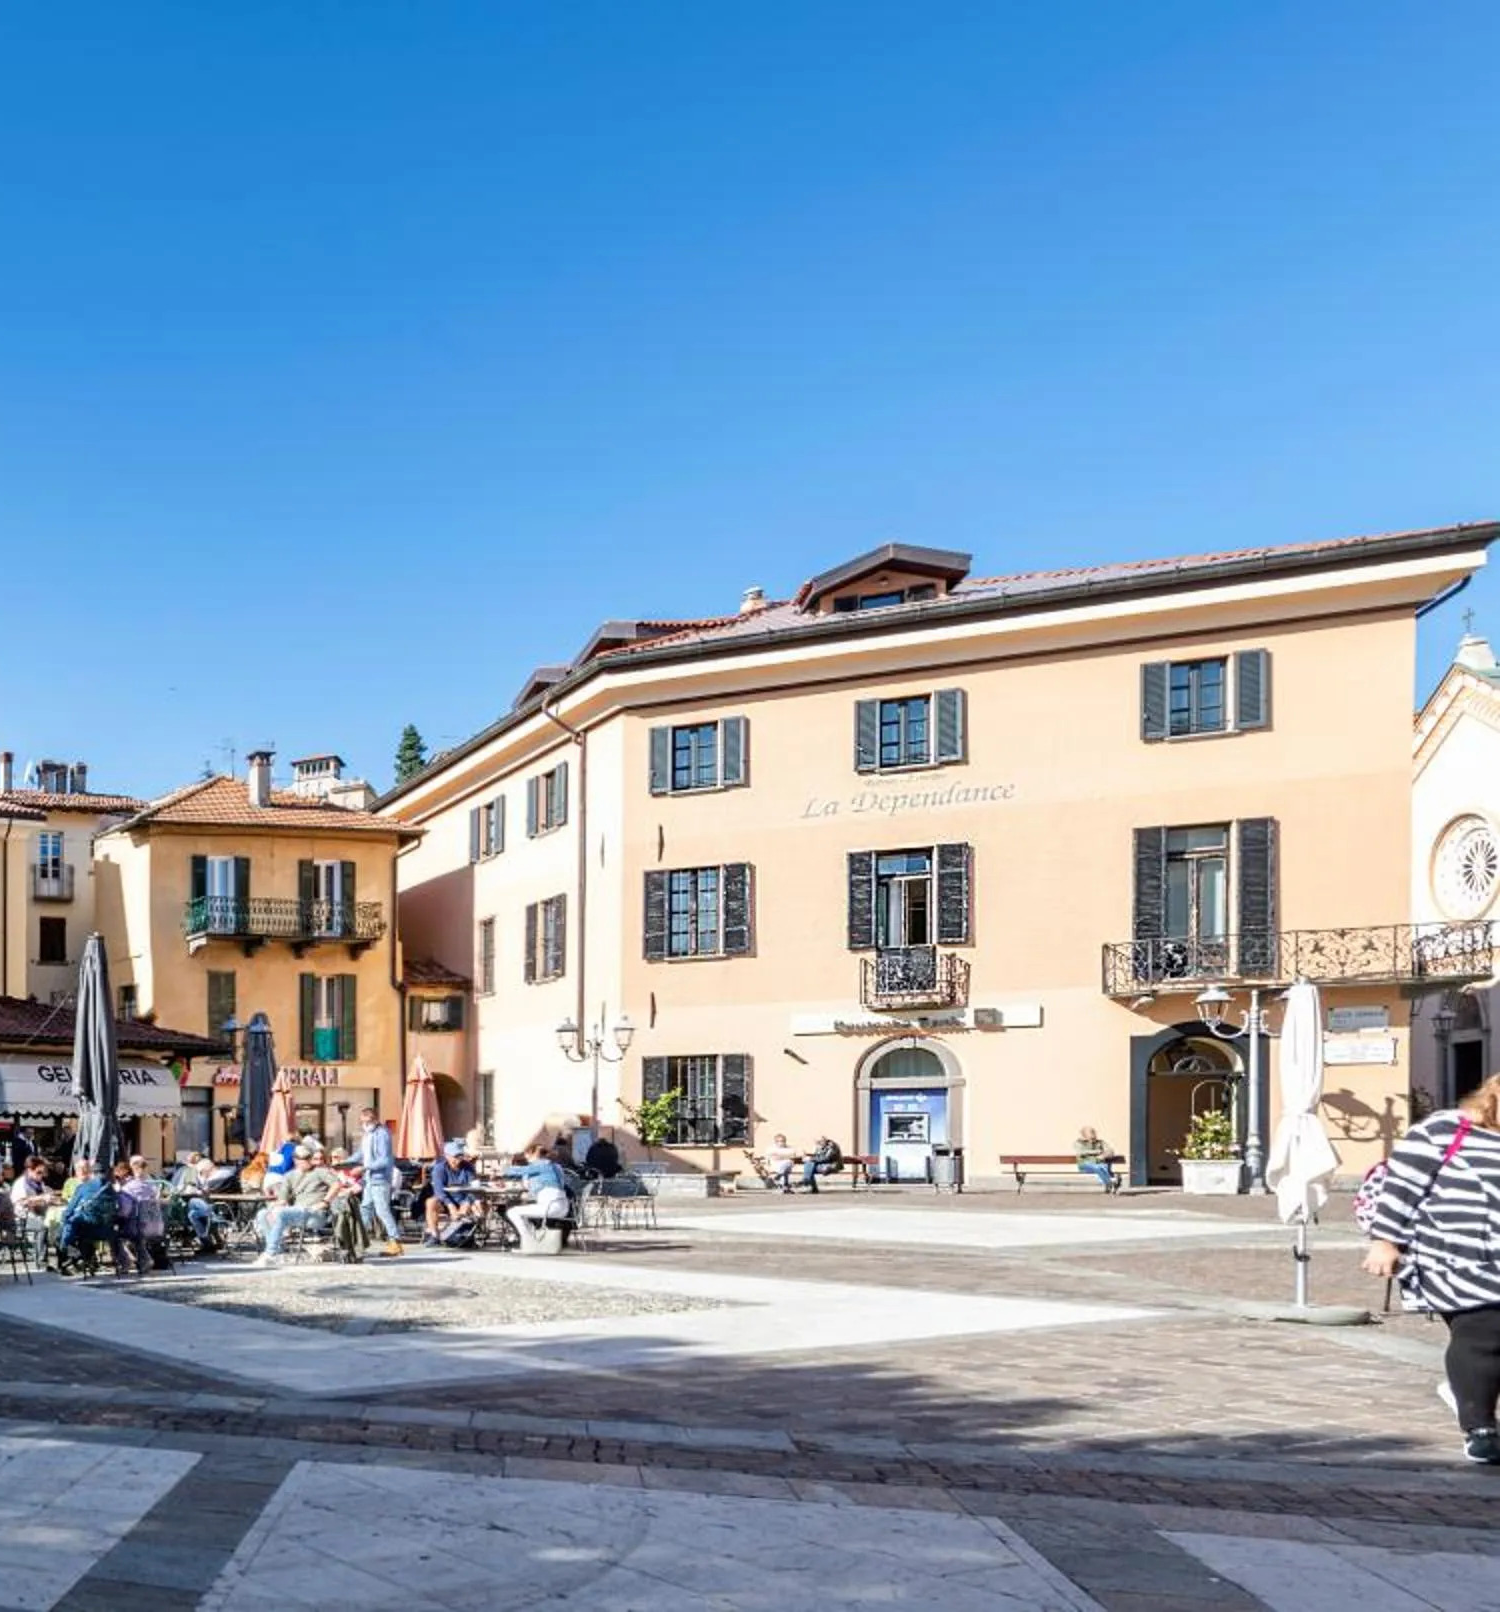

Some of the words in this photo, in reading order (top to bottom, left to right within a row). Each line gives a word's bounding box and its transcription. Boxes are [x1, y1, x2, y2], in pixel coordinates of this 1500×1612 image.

[800, 797, 840, 820] La
[851, 781, 1016, 817] Dependance
[37, 1065, 157, 1086] GELRIA
